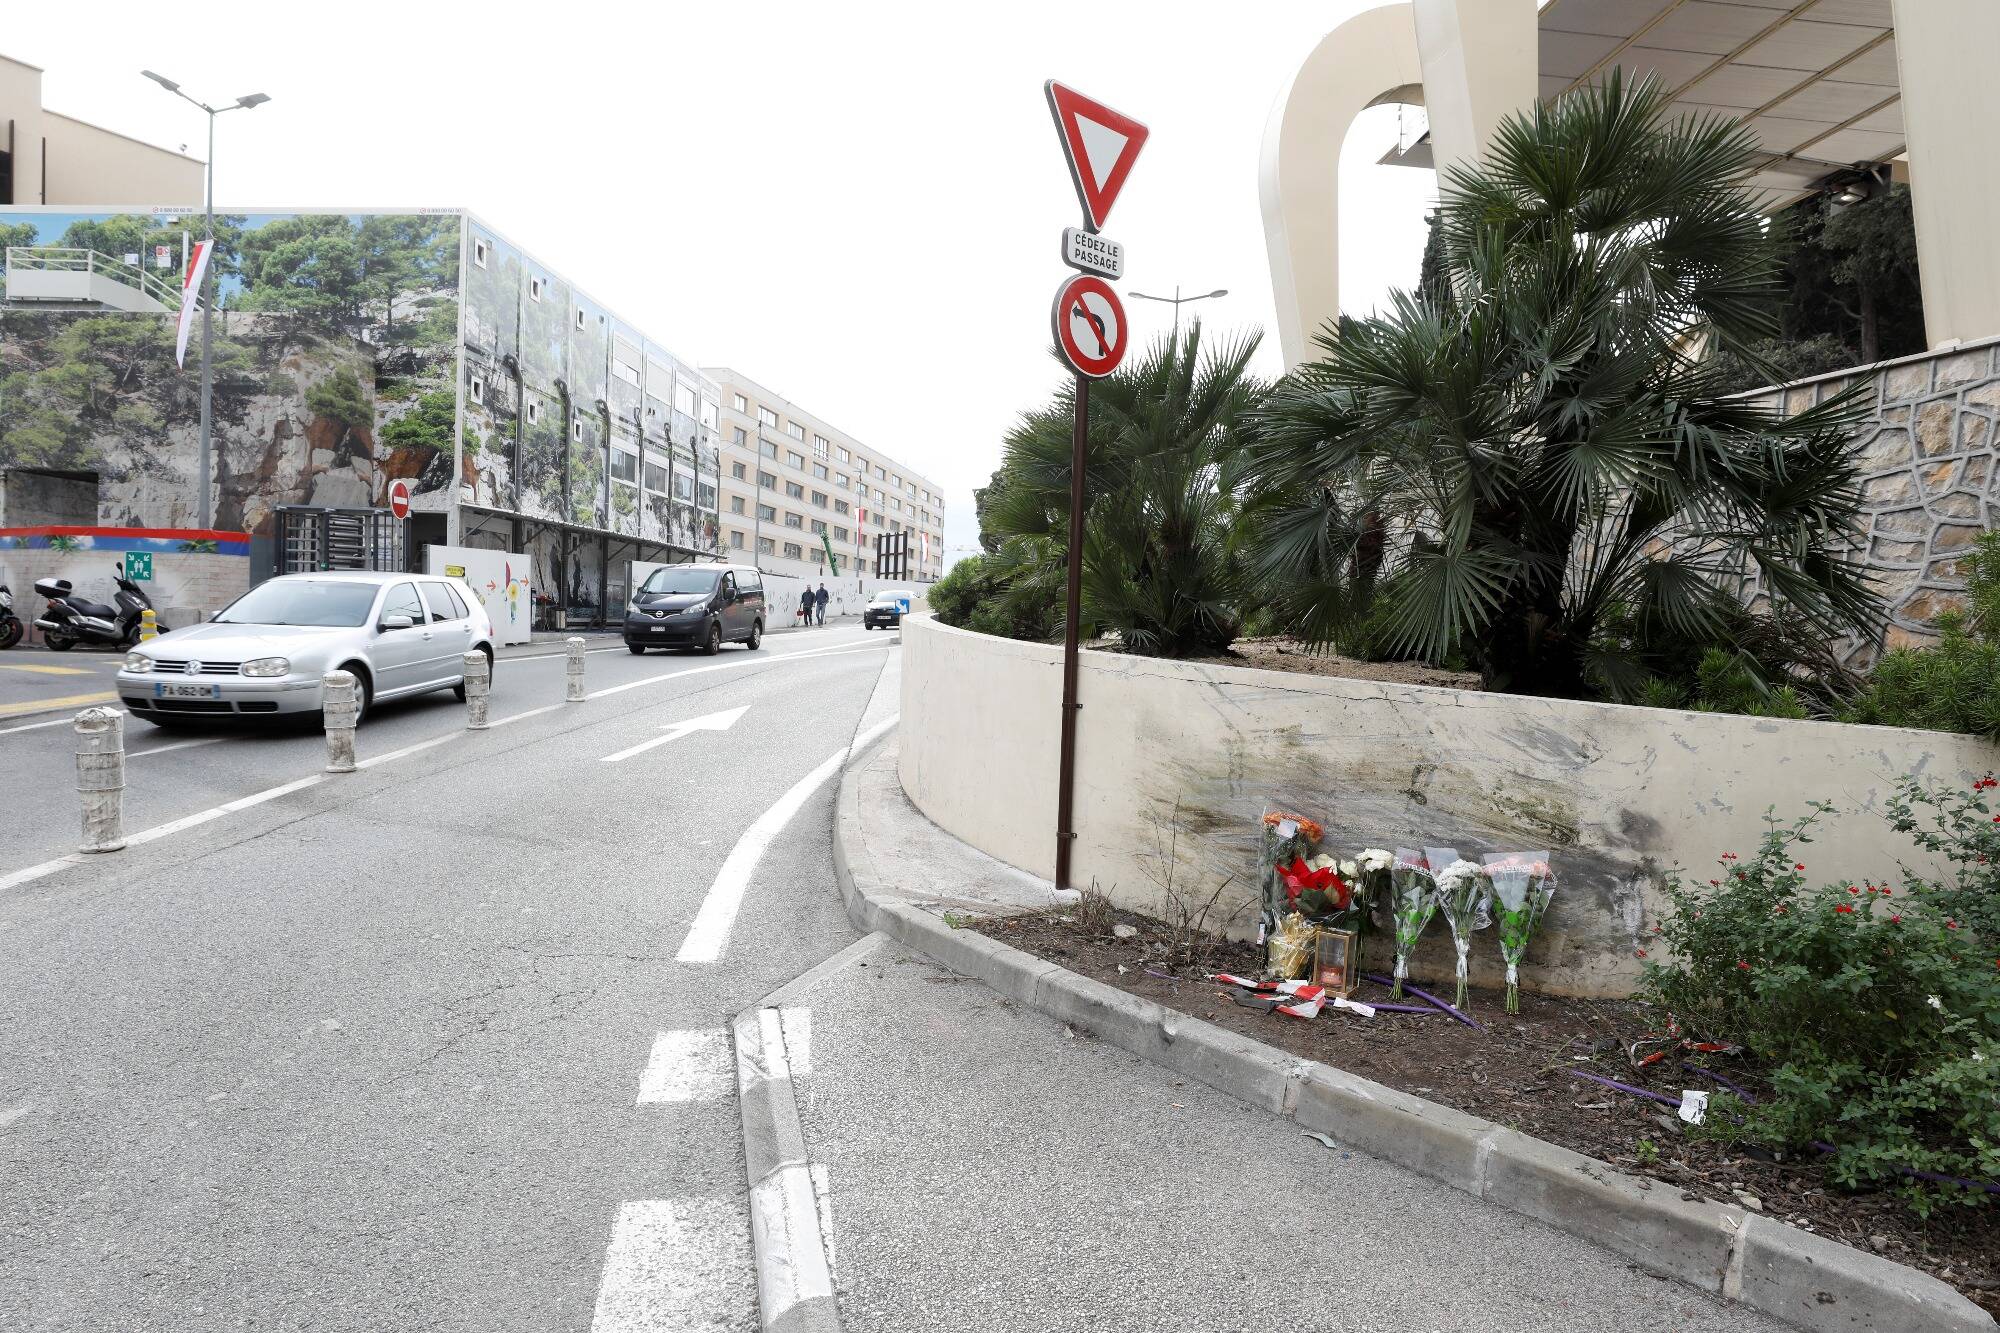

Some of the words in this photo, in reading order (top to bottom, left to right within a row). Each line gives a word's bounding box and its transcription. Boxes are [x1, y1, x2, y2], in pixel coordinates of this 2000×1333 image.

[1075, 233, 1105, 253] CÉDEZ
[1107, 244, 1118, 257] LE
[1074, 247, 1117, 271] PASSAGE
